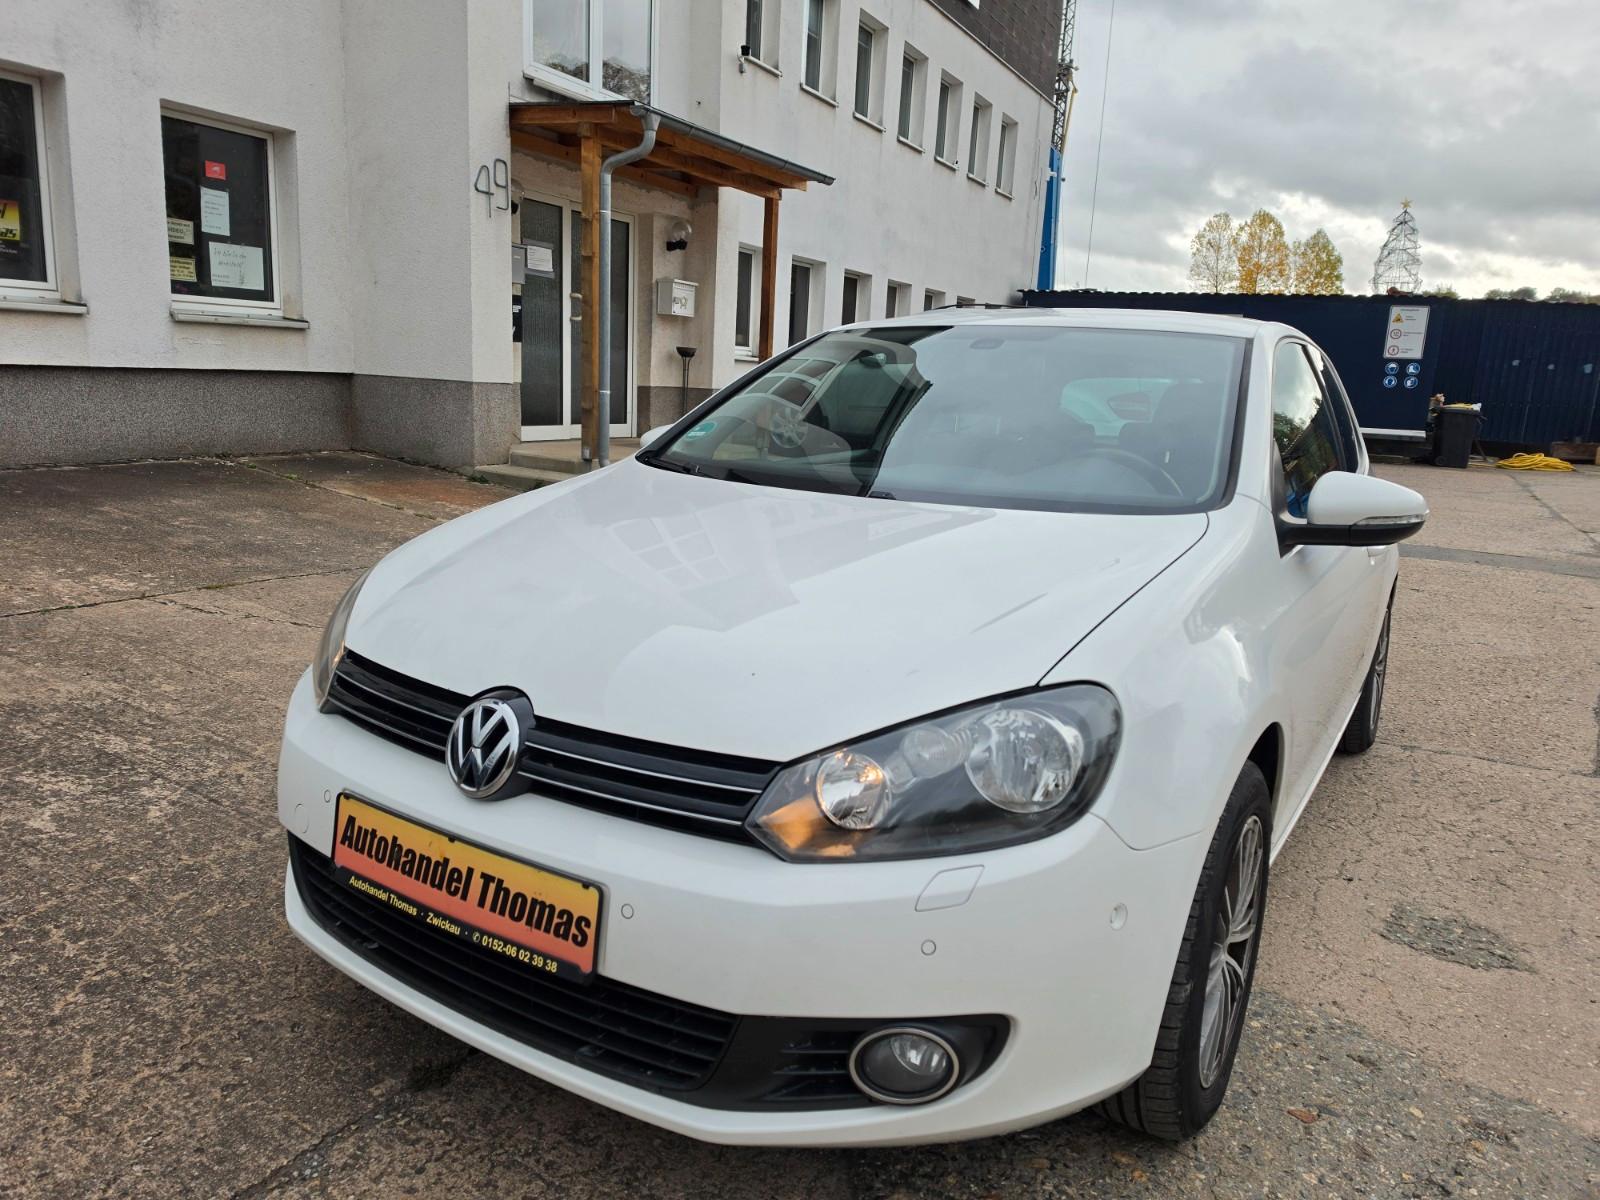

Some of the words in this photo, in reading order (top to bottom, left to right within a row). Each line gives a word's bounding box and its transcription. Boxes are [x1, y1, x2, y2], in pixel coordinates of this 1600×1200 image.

[475, 158, 509, 218] 49
[341, 815, 474, 902] Autohandel
[477, 872, 592, 948] Thomas
[349, 876, 389, 902] Autohandel
[389, 893, 417, 917] Thomas
[426, 911, 461, 936] Zwickau
[482, 935, 517, 958] 0152-06
[518, 948, 530, 963] 02
[531, 954, 544, 968] 39
[545, 958, 558, 973] 38
